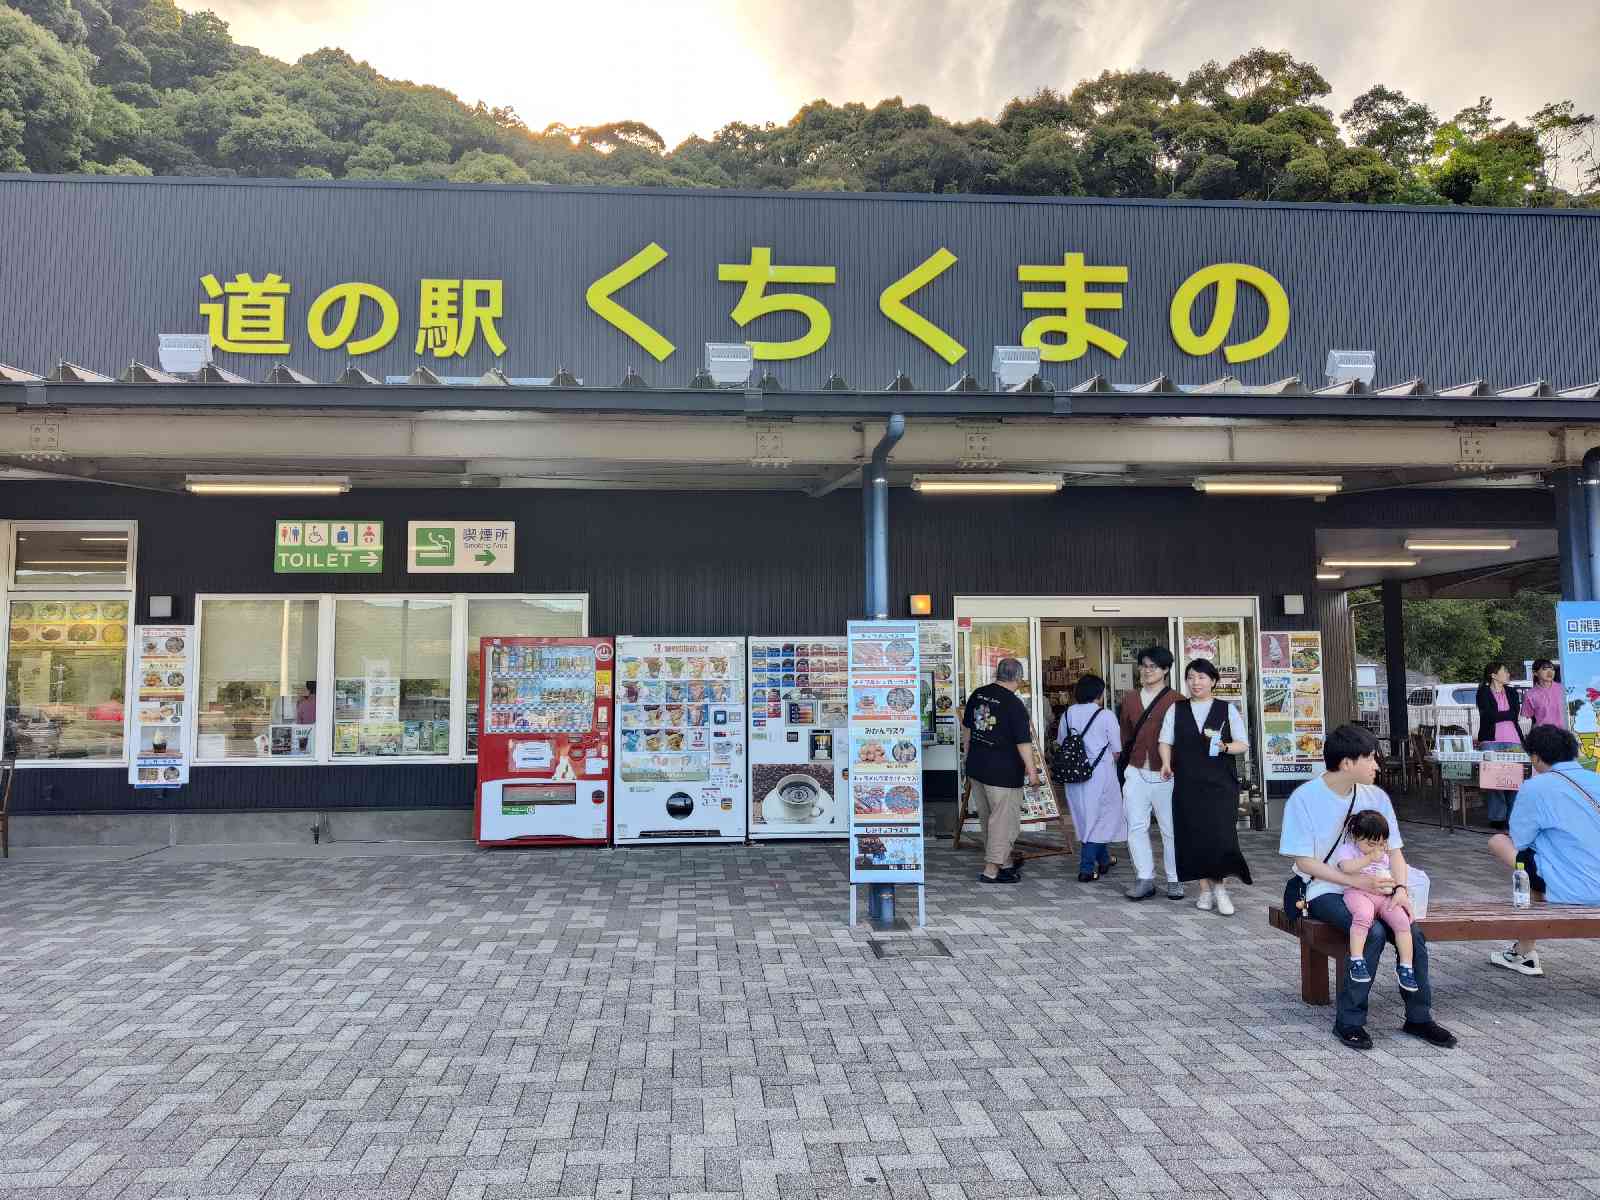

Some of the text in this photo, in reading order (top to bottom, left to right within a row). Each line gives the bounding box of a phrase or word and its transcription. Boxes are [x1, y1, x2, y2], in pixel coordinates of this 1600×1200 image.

[199, 242, 1290, 365] 道の駅 くちくまの
[463, 527, 512, 542] 喫煙所
[278, 552, 352, 568] TOILET
[864, 727, 905, 735] みかんラスク
